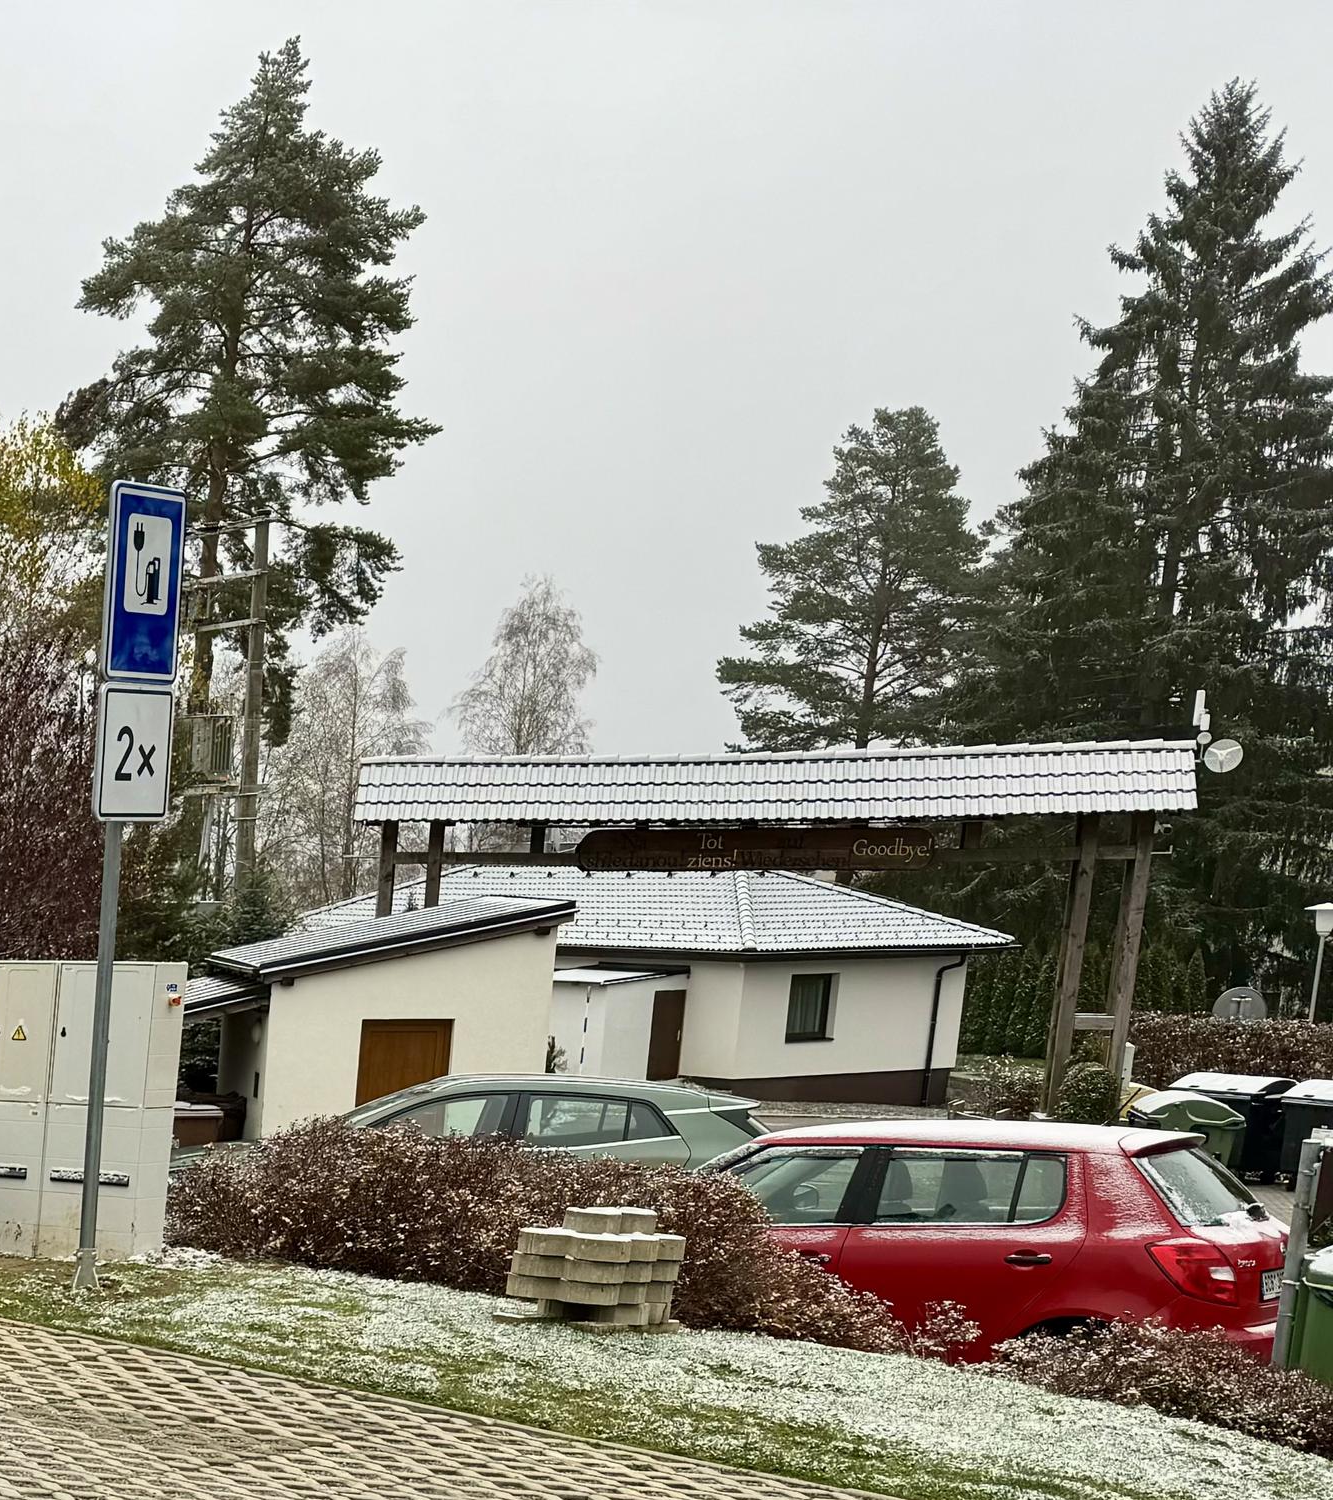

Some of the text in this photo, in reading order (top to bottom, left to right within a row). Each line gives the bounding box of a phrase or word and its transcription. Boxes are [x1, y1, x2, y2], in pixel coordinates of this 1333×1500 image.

[114, 725, 157, 782] 2x
[697, 832, 724, 850] Tot
[852, 837, 933, 863] Goodbye!
[687, 848, 738, 868] ziens!
